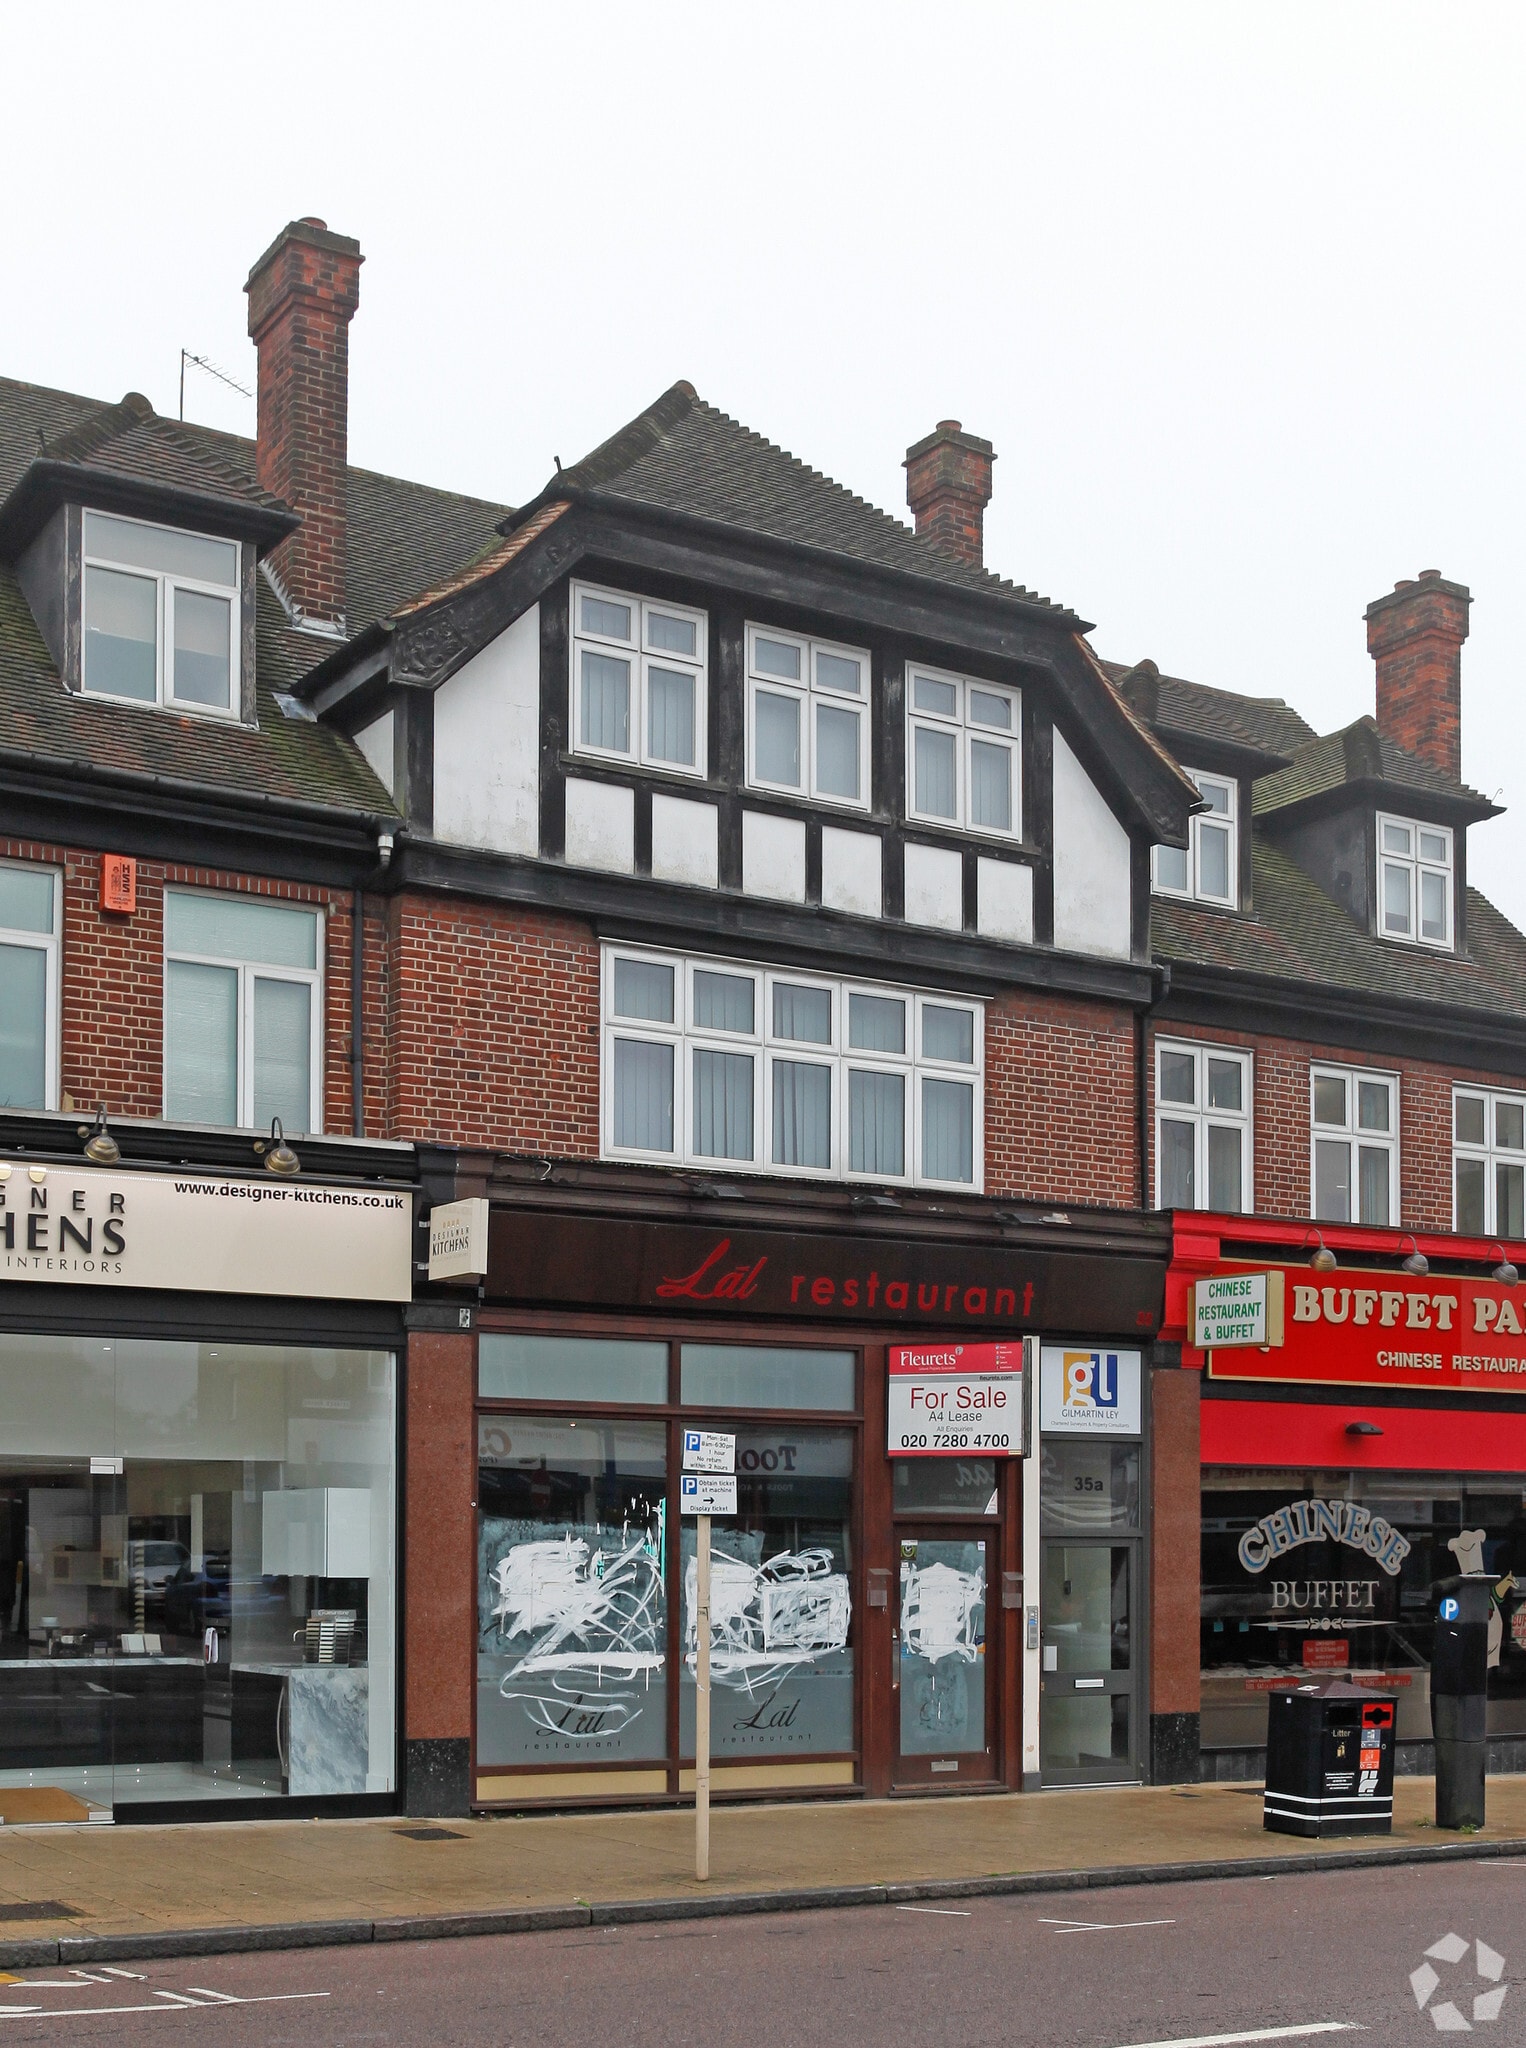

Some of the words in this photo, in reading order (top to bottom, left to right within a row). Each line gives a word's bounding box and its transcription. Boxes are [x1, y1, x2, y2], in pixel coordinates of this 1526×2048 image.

[174, 1182, 404, 1209] www.designer-kitchens.co.uk
[432, 1236, 469, 1257] KITCHENS
[6, 1256, 122, 1274] INTERIORS
[790, 1271, 1034, 1317] restaurant
[1208, 1280, 1252, 1299] CHINESE
[1198, 1302, 1262, 1321] RESTAURANT
[1292, 1285, 1458, 1331] BUFFET
[1472, 1297, 1526, 1335] PA
[1203, 1326, 1211, 1340] &
[1216, 1323, 1255, 1339] BUFFET
[900, 1351, 956, 1366] Fleurets
[1377, 1351, 1443, 1370] CHINESE
[911, 1387, 948, 1409] For
[956, 1386, 1007, 1409] Sale
[929, 1411, 944, 1422] A4
[948, 1410, 983, 1422] Lease
[1061, 1409, 1104, 1418] GILMARTIN
[1106, 1411, 1119, 1419] LEY
[946, 1425, 974, 1433] Enquiries
[901, 1434, 927, 1448] 020
[933, 1434, 968, 1447] 7280
[973, 1434, 1009, 1447] 4700
[1074, 1476, 1104, 1491] 35a
[1238, 1499, 1411, 1576] CHINESE
[1270, 1580, 1380, 1609] BUFFET
[722, 1733, 811, 1744] restaurant
[1332, 1729, 1351, 1738] Litter
[524, 1740, 622, 1750] restaurant
